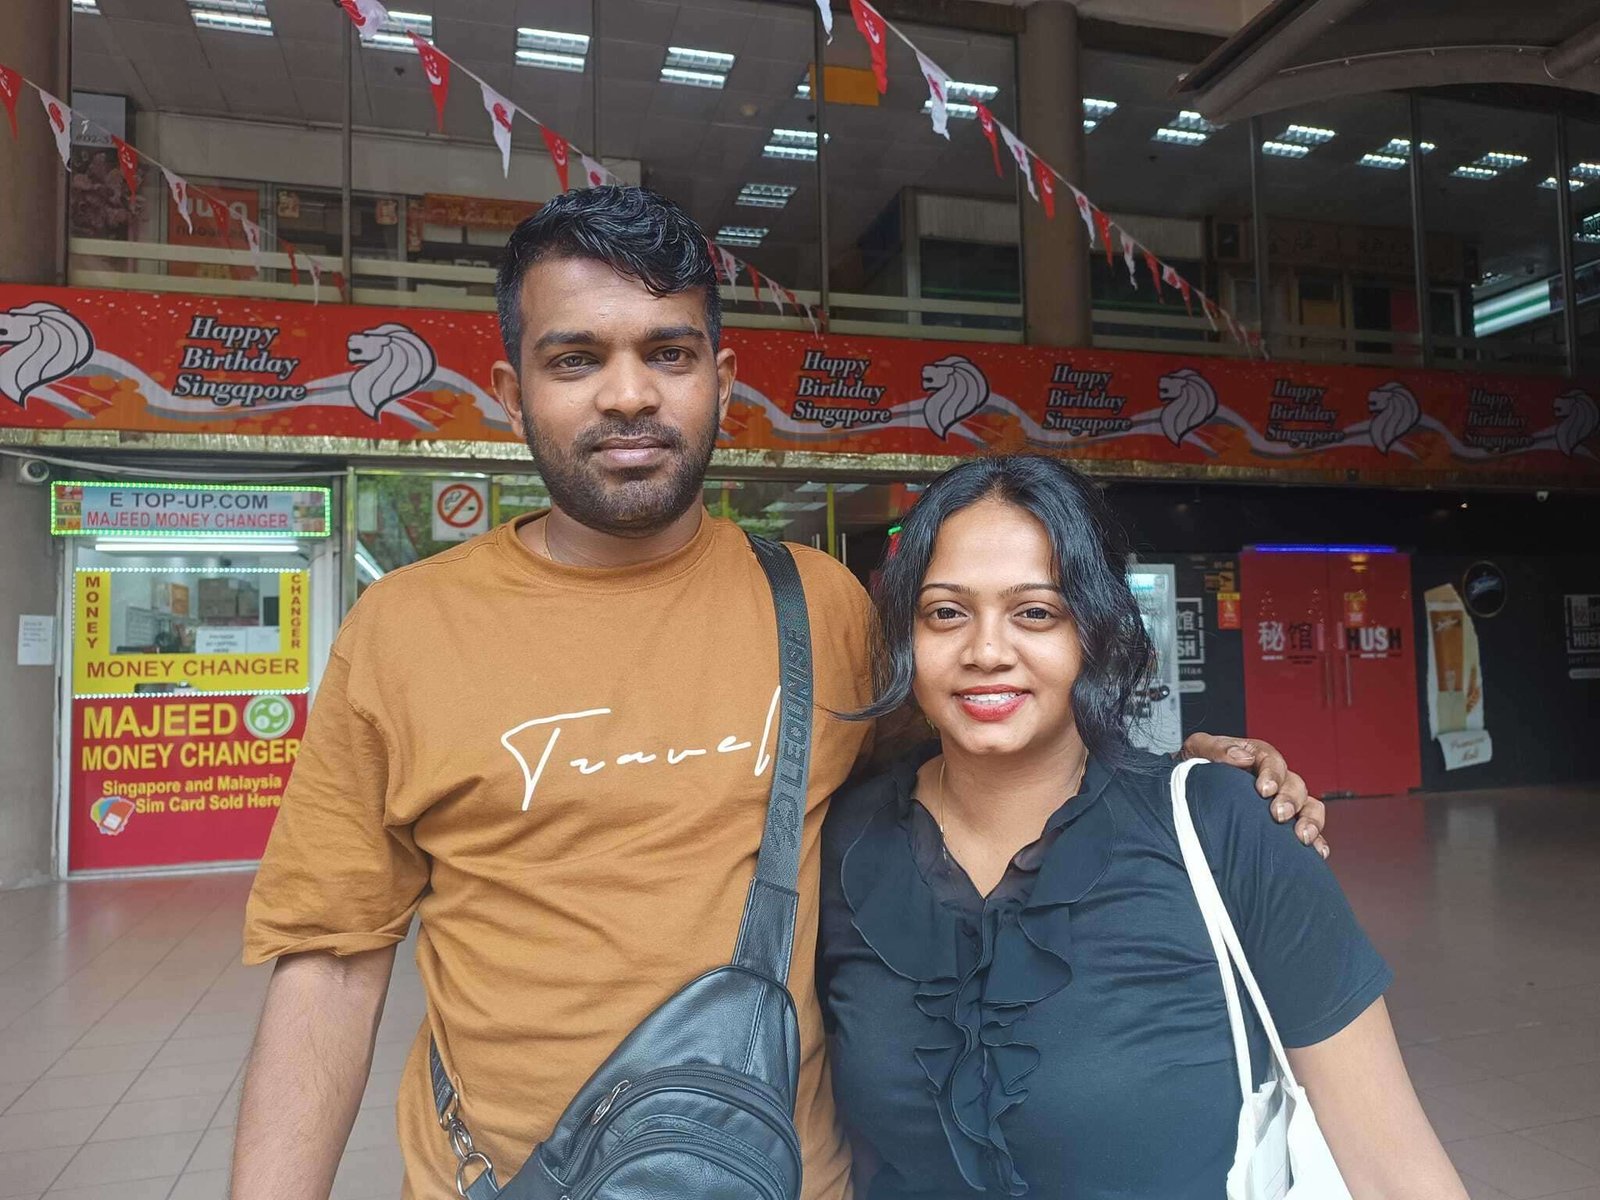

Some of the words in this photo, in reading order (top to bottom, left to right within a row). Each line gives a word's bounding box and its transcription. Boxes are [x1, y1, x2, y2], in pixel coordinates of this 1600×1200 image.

[187, 315, 279, 349] Happy
[181, 346, 299, 380] Birthday
[803, 350, 870, 378] Happy
[1053, 364, 1112, 390] Happy
[173, 373, 306, 406] Singapore
[797, 377, 886, 405] Birthday
[1047, 389, 1127, 415] Birthday
[791, 400, 892, 428] Singapore
[1043, 410, 1133, 437] Singapore
[110, 492, 123, 508] E
[132, 493, 268, 510] TOP-UP.COM
[87, 511, 151, 528] MAJEED
[156, 512, 210, 528] MONEY
[215, 513, 289, 528] CHANGER
[85, 576, 101, 649] MONEY
[291, 574, 301, 649] CHANGER
[87, 660, 175, 678] MONEY
[183, 658, 300, 676] CHANGER
[83, 703, 238, 740] MAJEED
[82, 743, 174, 771] MONEY
[180, 739, 301, 767] CHANGER
[500, 685, 782, 812] Travel
[102, 780, 182, 798] Singapore
[185, 777, 213, 793] and
[217, 774, 283, 793] Malaysia
[135, 798, 165, 814] Sim
[169, 796, 205, 812] Card
[209, 795, 243, 811] Sold
[247, 794, 282, 808] Here
